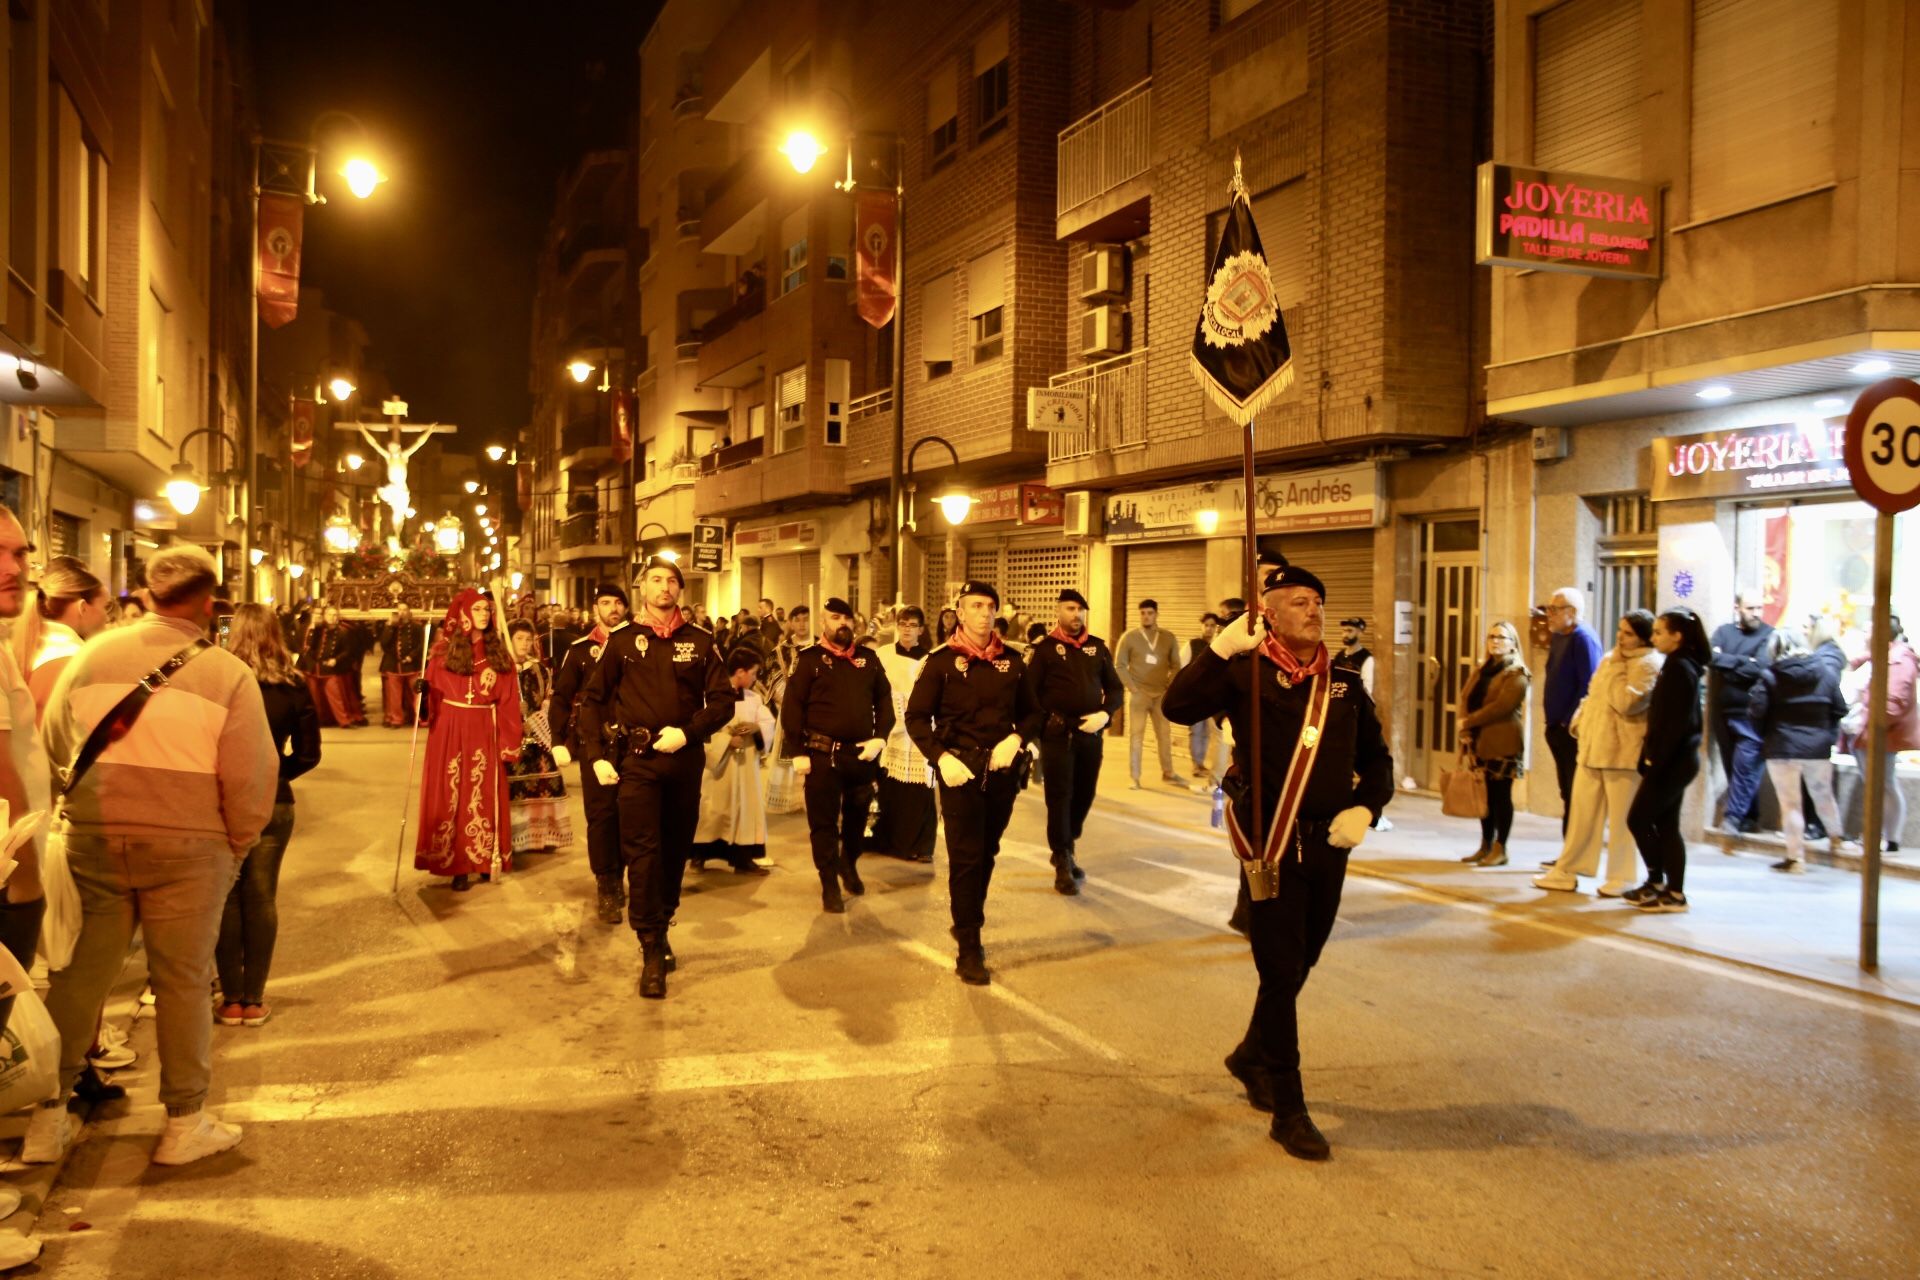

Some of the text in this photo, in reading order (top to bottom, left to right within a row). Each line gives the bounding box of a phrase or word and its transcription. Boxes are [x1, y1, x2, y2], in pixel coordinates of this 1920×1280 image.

[1504, 181, 1650, 225] JOYERIA
[1499, 213, 1585, 244] PADILLA
[1523, 242, 1631, 264] TALLER DE JOYERIA
[1217, 326, 1242, 338] LOCAL
[1668, 428, 1818, 476] JOYERIA
[1870, 422, 1920, 468] 30
[1286, 478, 1352, 507] Andrés
[1146, 506, 1165, 524] San
[703, 527, 715, 542] P
